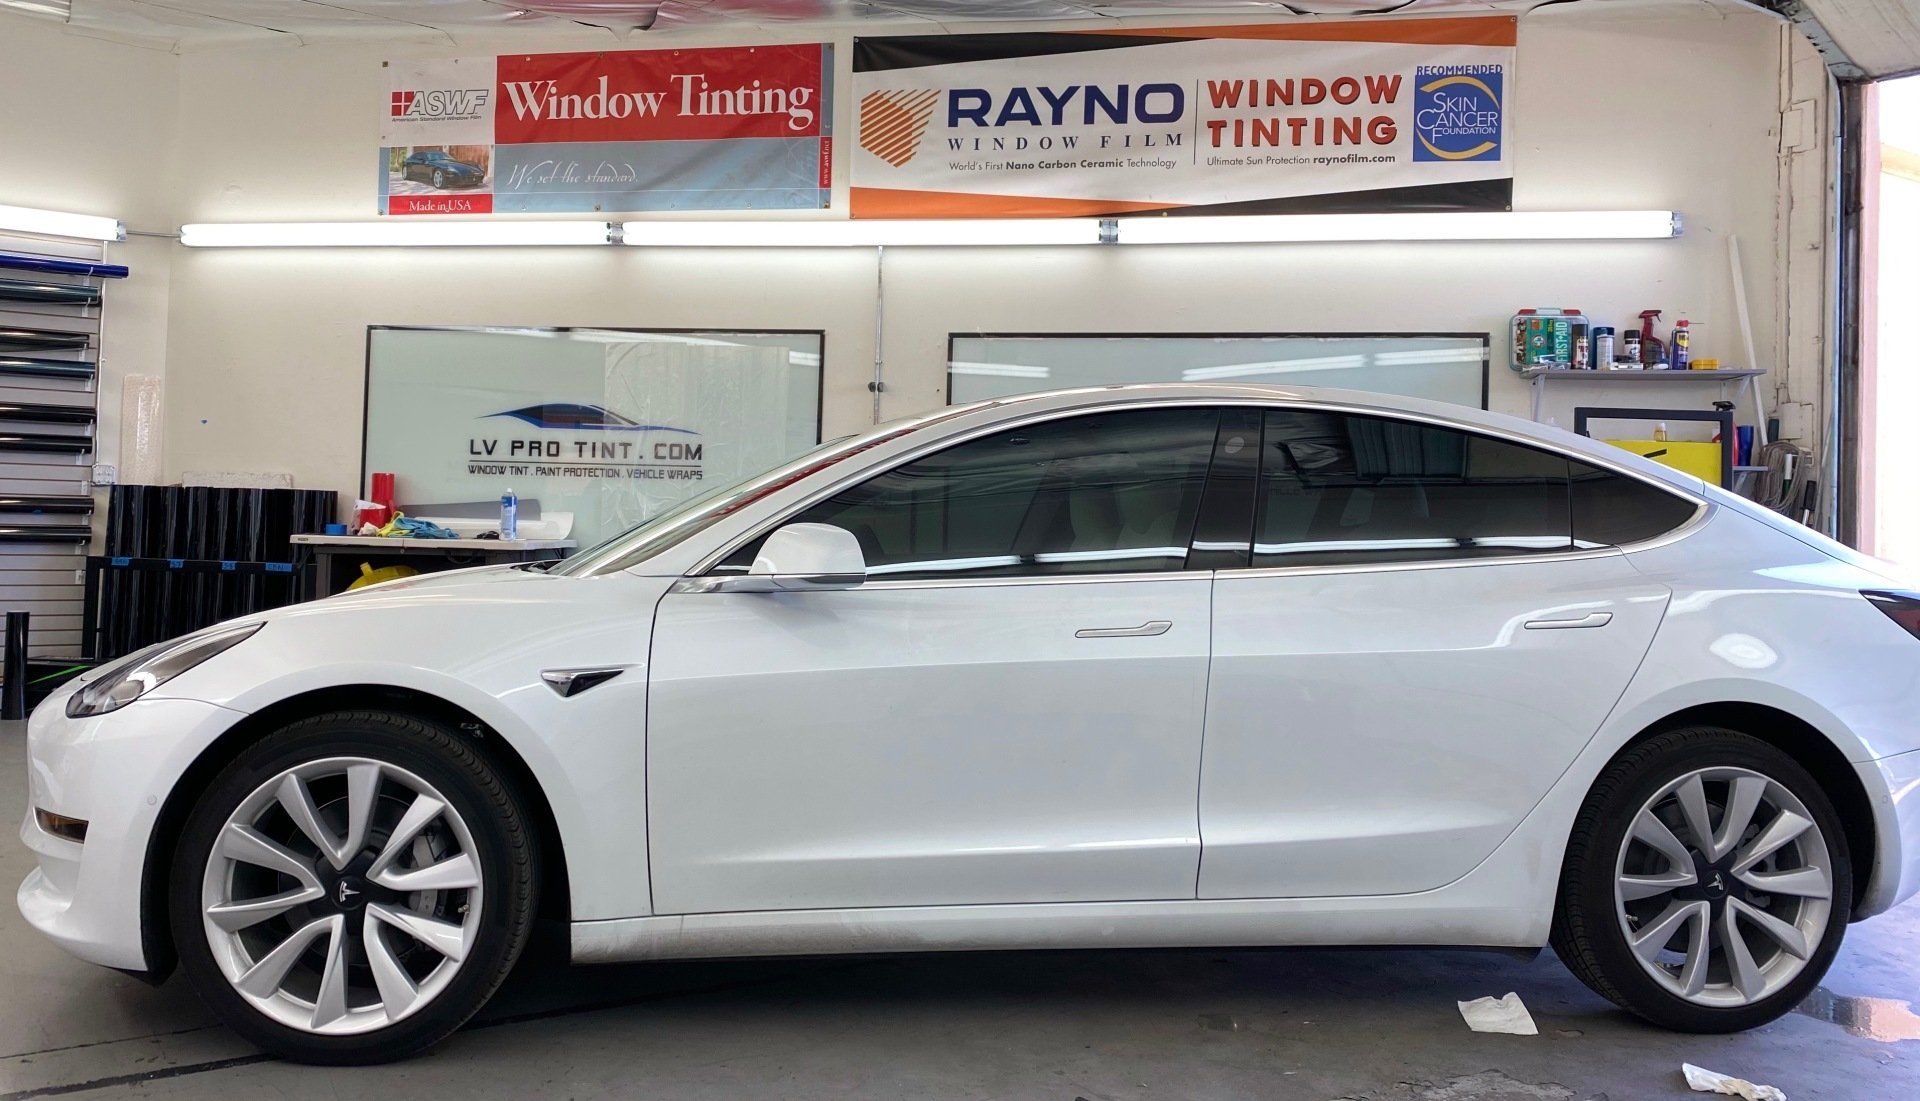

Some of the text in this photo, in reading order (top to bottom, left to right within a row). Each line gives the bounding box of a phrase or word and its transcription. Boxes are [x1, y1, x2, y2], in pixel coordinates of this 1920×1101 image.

[1417, 64, 1503, 75] RECOMMENDED
[1207, 74, 1403, 109] WINDOW
[404, 89, 489, 116] ASWF
[502, 74, 814, 130] Window Tinting
[947, 83, 1185, 127] RAYNO
[1433, 92, 1477, 112] SKIN
[1417, 109, 1498, 129] CANCER
[1206, 115, 1398, 148] TINTING
[1432, 127, 1496, 144] FOUNDATION
[947, 133, 1182, 151] WINDOW FILM
[949, 157, 1177, 171] World's First Nano Carbon Ceramic Technology
[1207, 153, 1396, 166] Ultimate Sun Protection raynofilm.com
[408, 200, 472, 212] Made in USA
[470, 439, 498, 455] LV
[511, 440, 560, 457] PRO
[468, 465, 506, 475] WINDOW
[509, 466, 529, 476] TINT
[535, 466, 561, 476] PAINT
[563, 467, 620, 478] PROTECTION
[627, 469, 665, 479] VEHICLE
[667, 470, 703, 480] WRAPS
